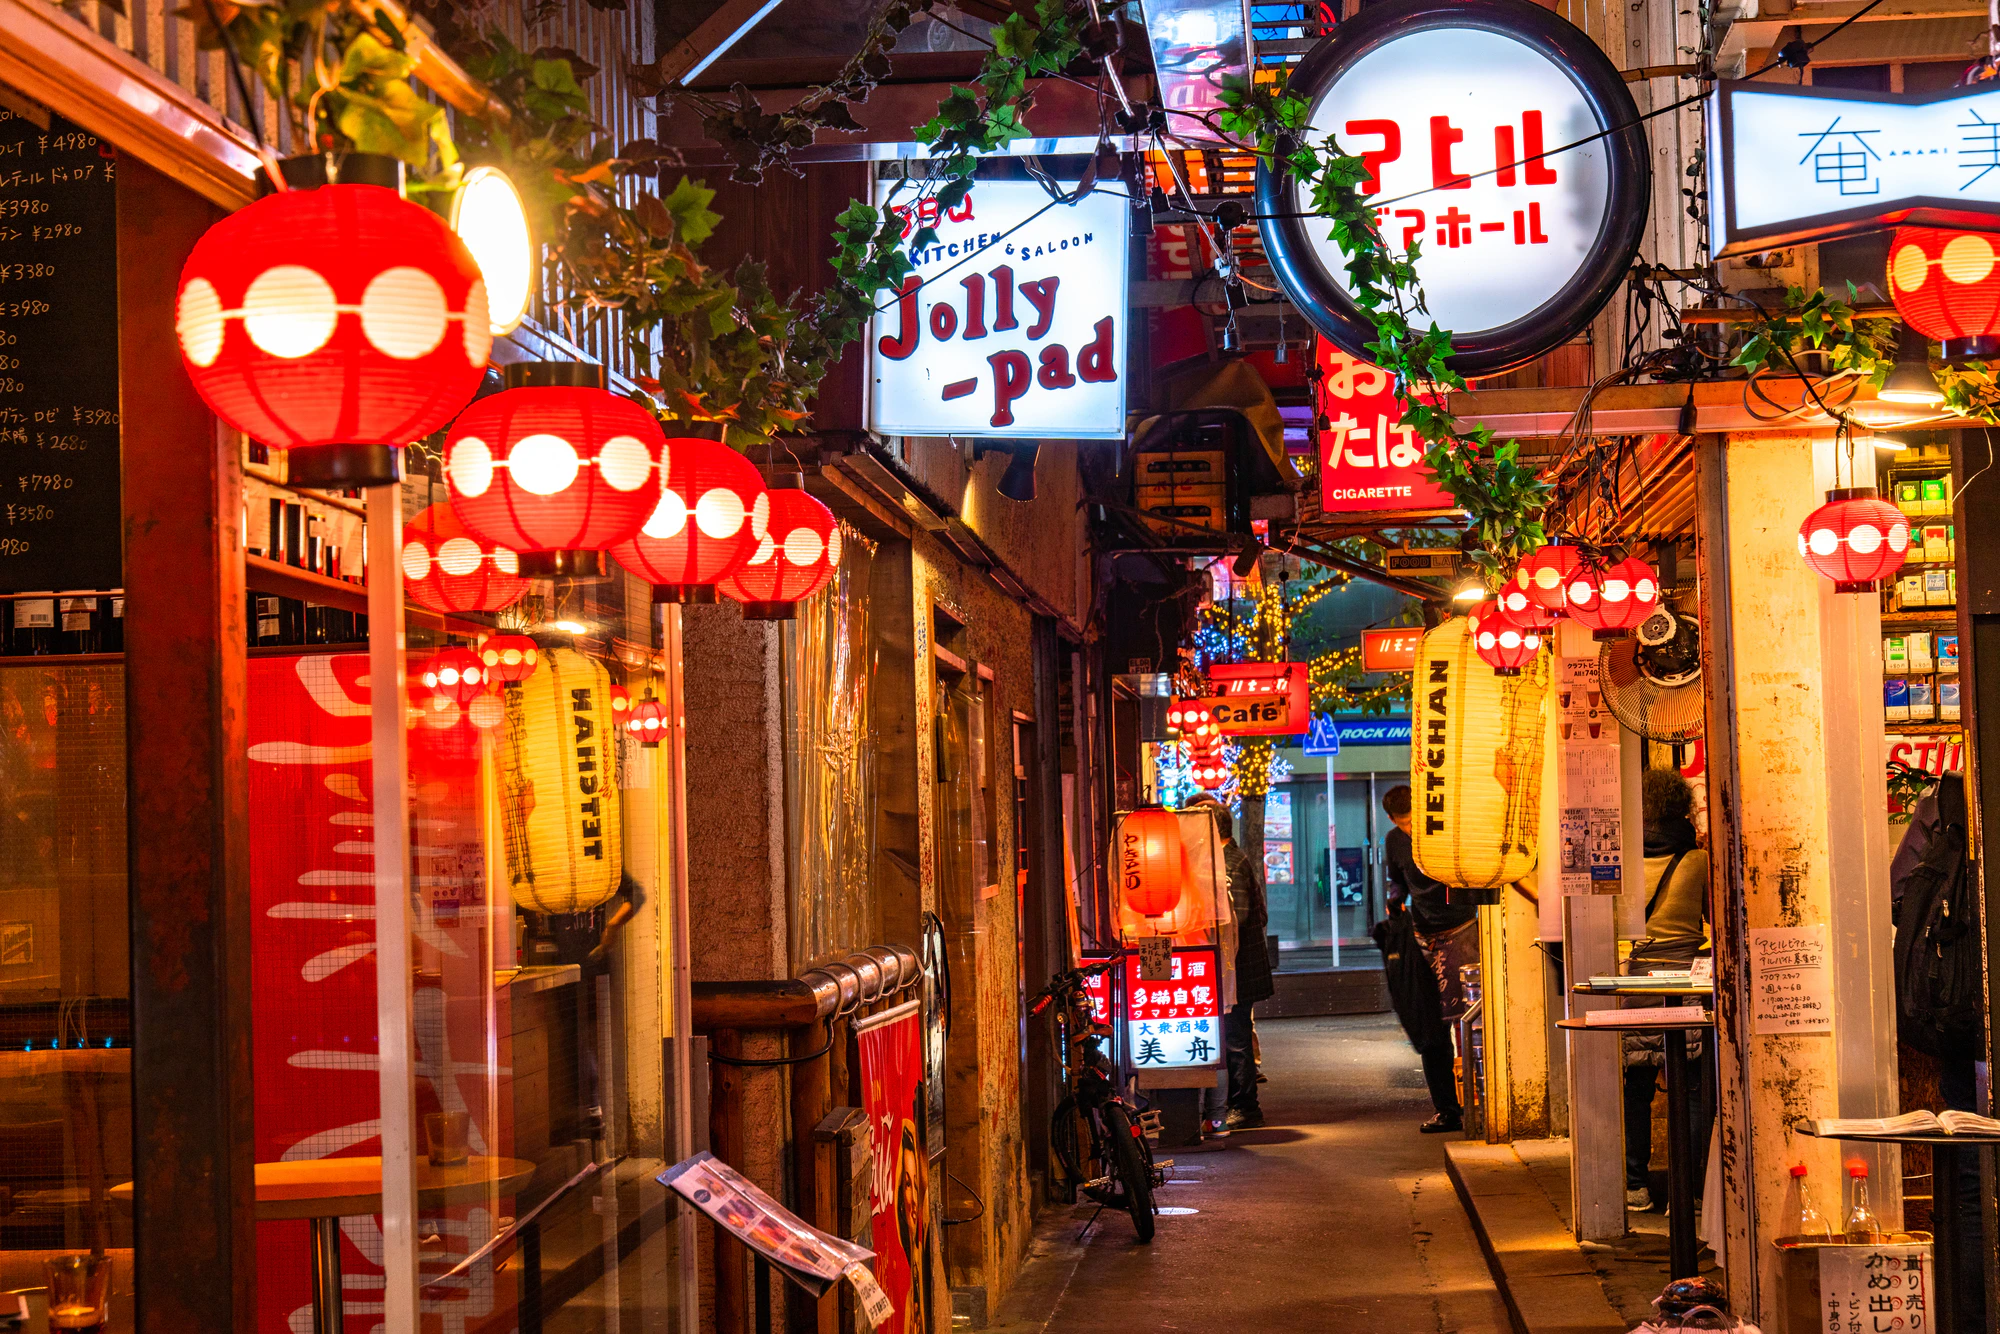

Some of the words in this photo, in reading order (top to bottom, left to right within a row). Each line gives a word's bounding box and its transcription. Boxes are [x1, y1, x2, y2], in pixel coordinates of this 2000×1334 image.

[1345, 110, 1557, 195] アヒル
[1799, 116, 1881, 195] 奄
[1889, 148, 1948, 156] AMAMI
[32, 223, 82, 241] ¥2980
[910, 232, 1001, 267] KITCHEN
[1005, 243, 1015, 255] &
[1021, 233, 1093, 261] SALOON
[878, 264, 1060, 361] Jolly
[72, 406, 119, 426] ¥3980
[19, 474, 73, 492] ¥7980
[1333, 486, 1412, 500] CIGARETTE
[7, 503, 54, 525] ¥3580
[1391, 557, 1429, 568] FOOD
[1212, 702, 1278, 723] Café
[1340, 727, 1387, 739] ROCK
[1414, 701, 1427, 777] Yakitori
[1426, 660, 1449, 835] TETCHAN
[1134, 1006, 1212, 1019] タマジマン
[1139, 1019, 1210, 1036] 大衆酒場
[1865, 1252, 1893, 1332] かめ出し
[1903, 1255, 1924, 1329] 量り売り
